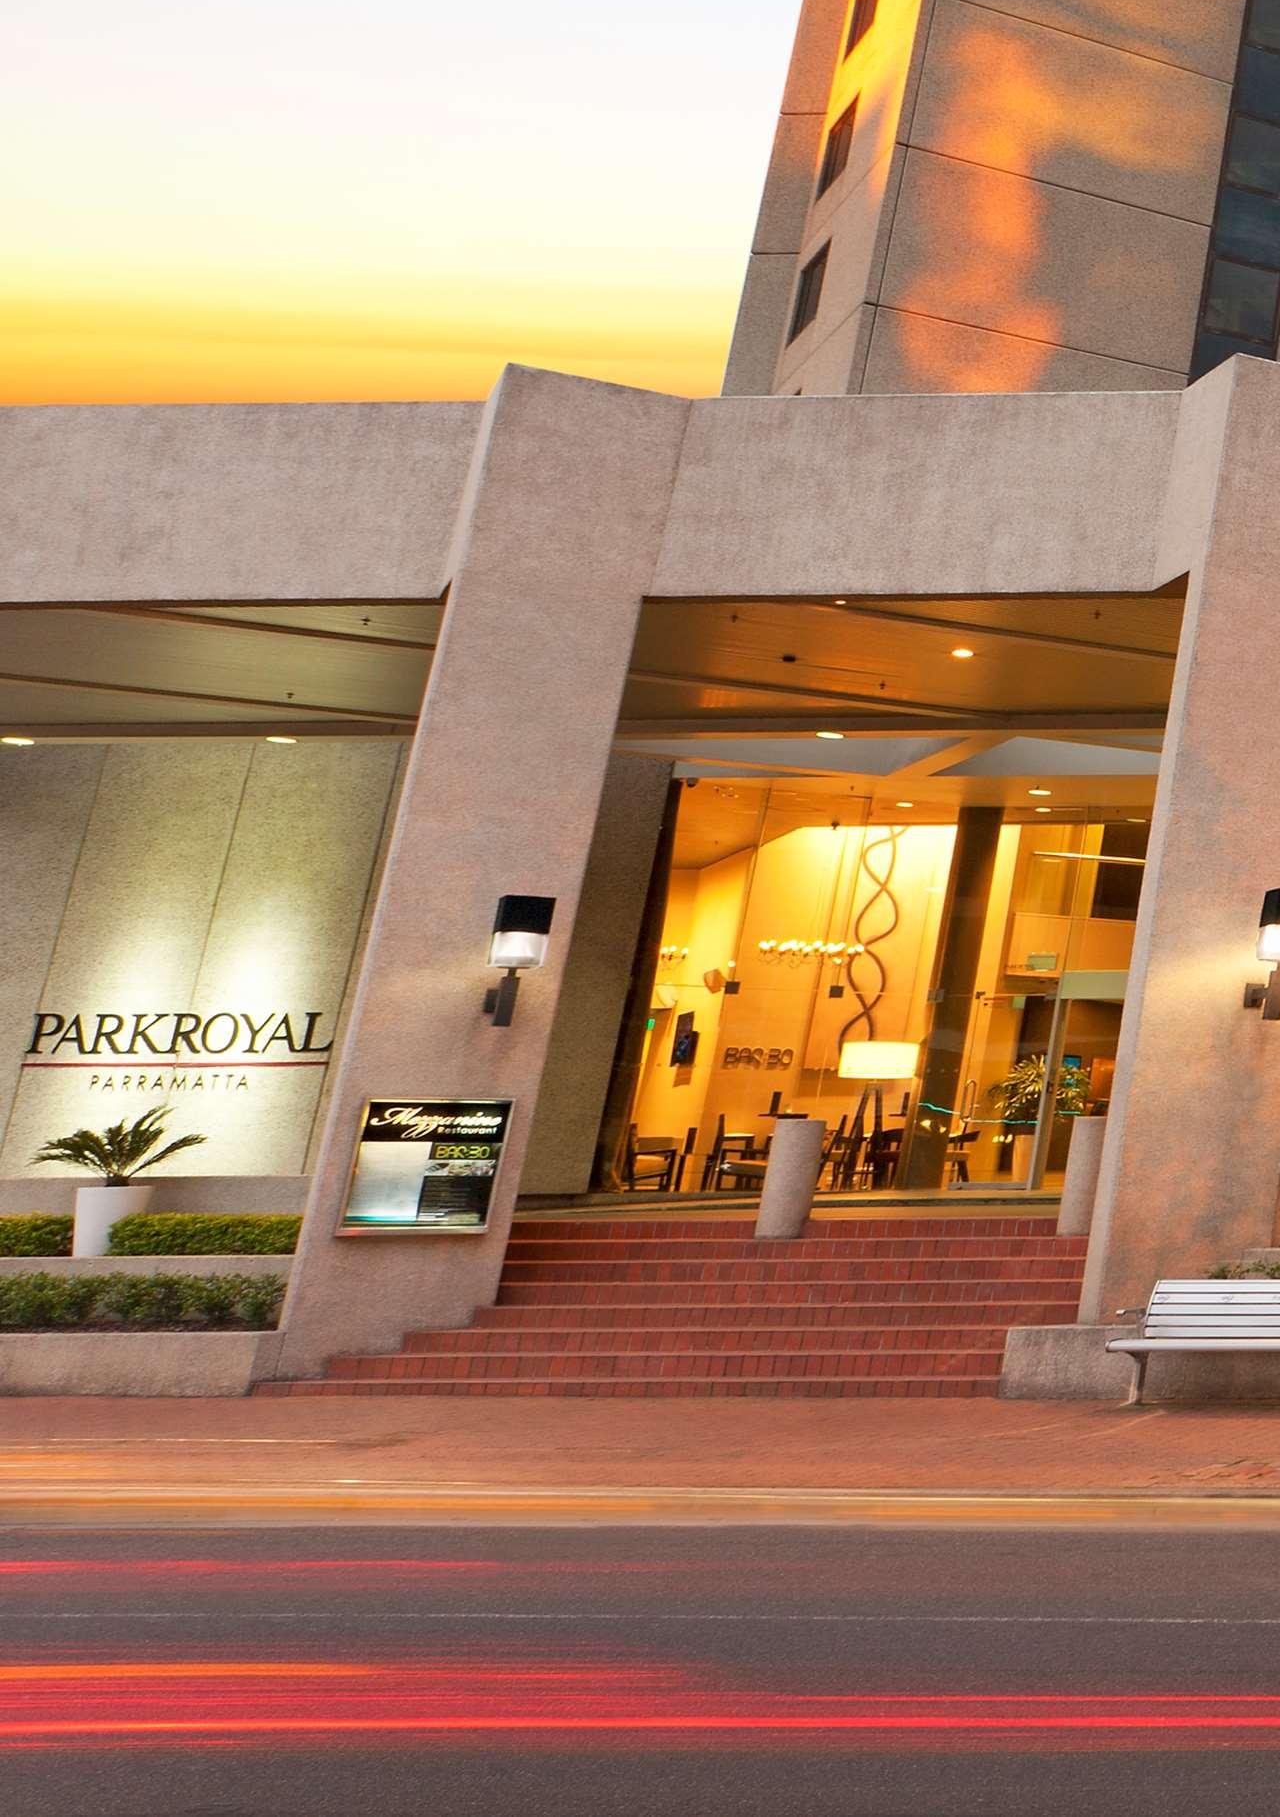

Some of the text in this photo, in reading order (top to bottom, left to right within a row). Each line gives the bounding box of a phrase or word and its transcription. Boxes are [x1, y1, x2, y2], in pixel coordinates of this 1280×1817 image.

[25, 1012, 334, 1054] PARKROYAL
[89, 1074, 249, 1091] PARRAMATTA
[370, 1106, 502, 1138] Mezzanine
[437, 1127, 498, 1135] Restaurant
